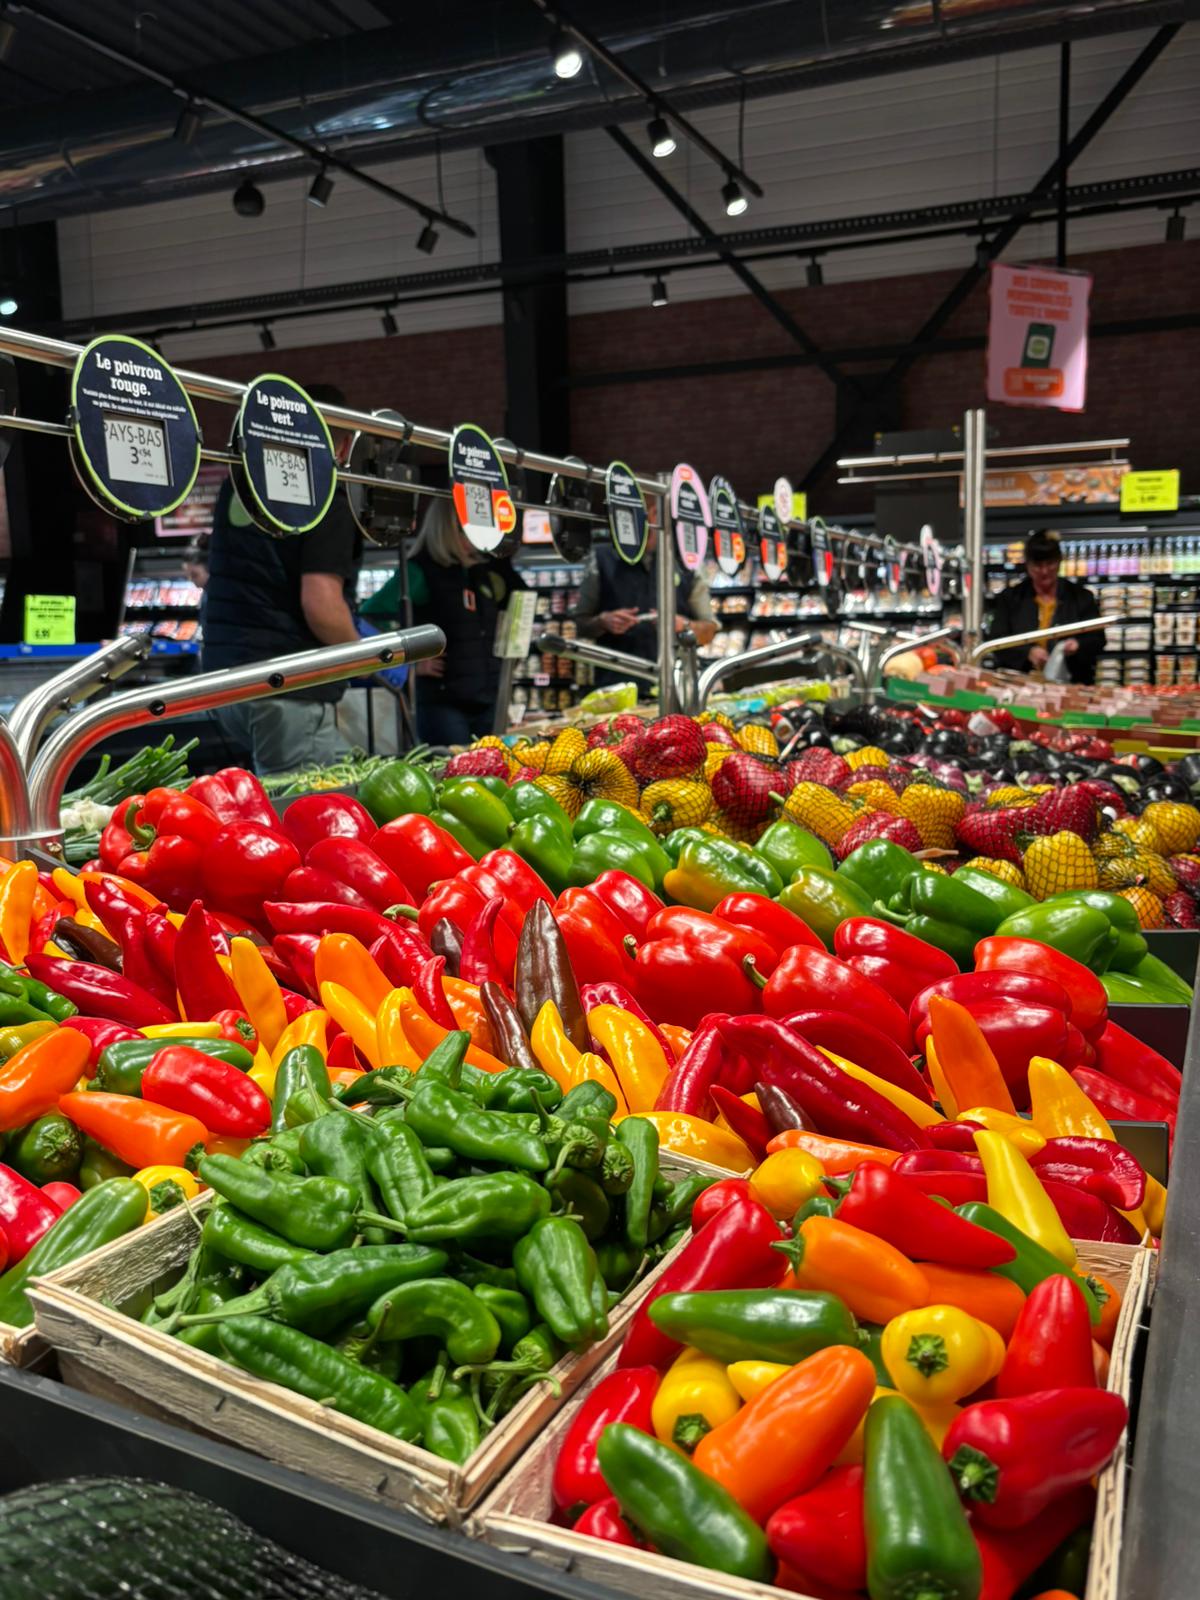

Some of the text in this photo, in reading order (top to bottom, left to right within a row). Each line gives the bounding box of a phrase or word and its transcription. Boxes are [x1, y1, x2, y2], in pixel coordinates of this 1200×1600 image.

[95, 352, 163, 381] Le poivron
[110, 377, 152, 397] rouge.
[256, 389, 308, 415] Le poivron
[271, 411, 295, 427] vert.
[457, 442, 467, 456] Le
[264, 450, 306, 472] AYS-BAS
